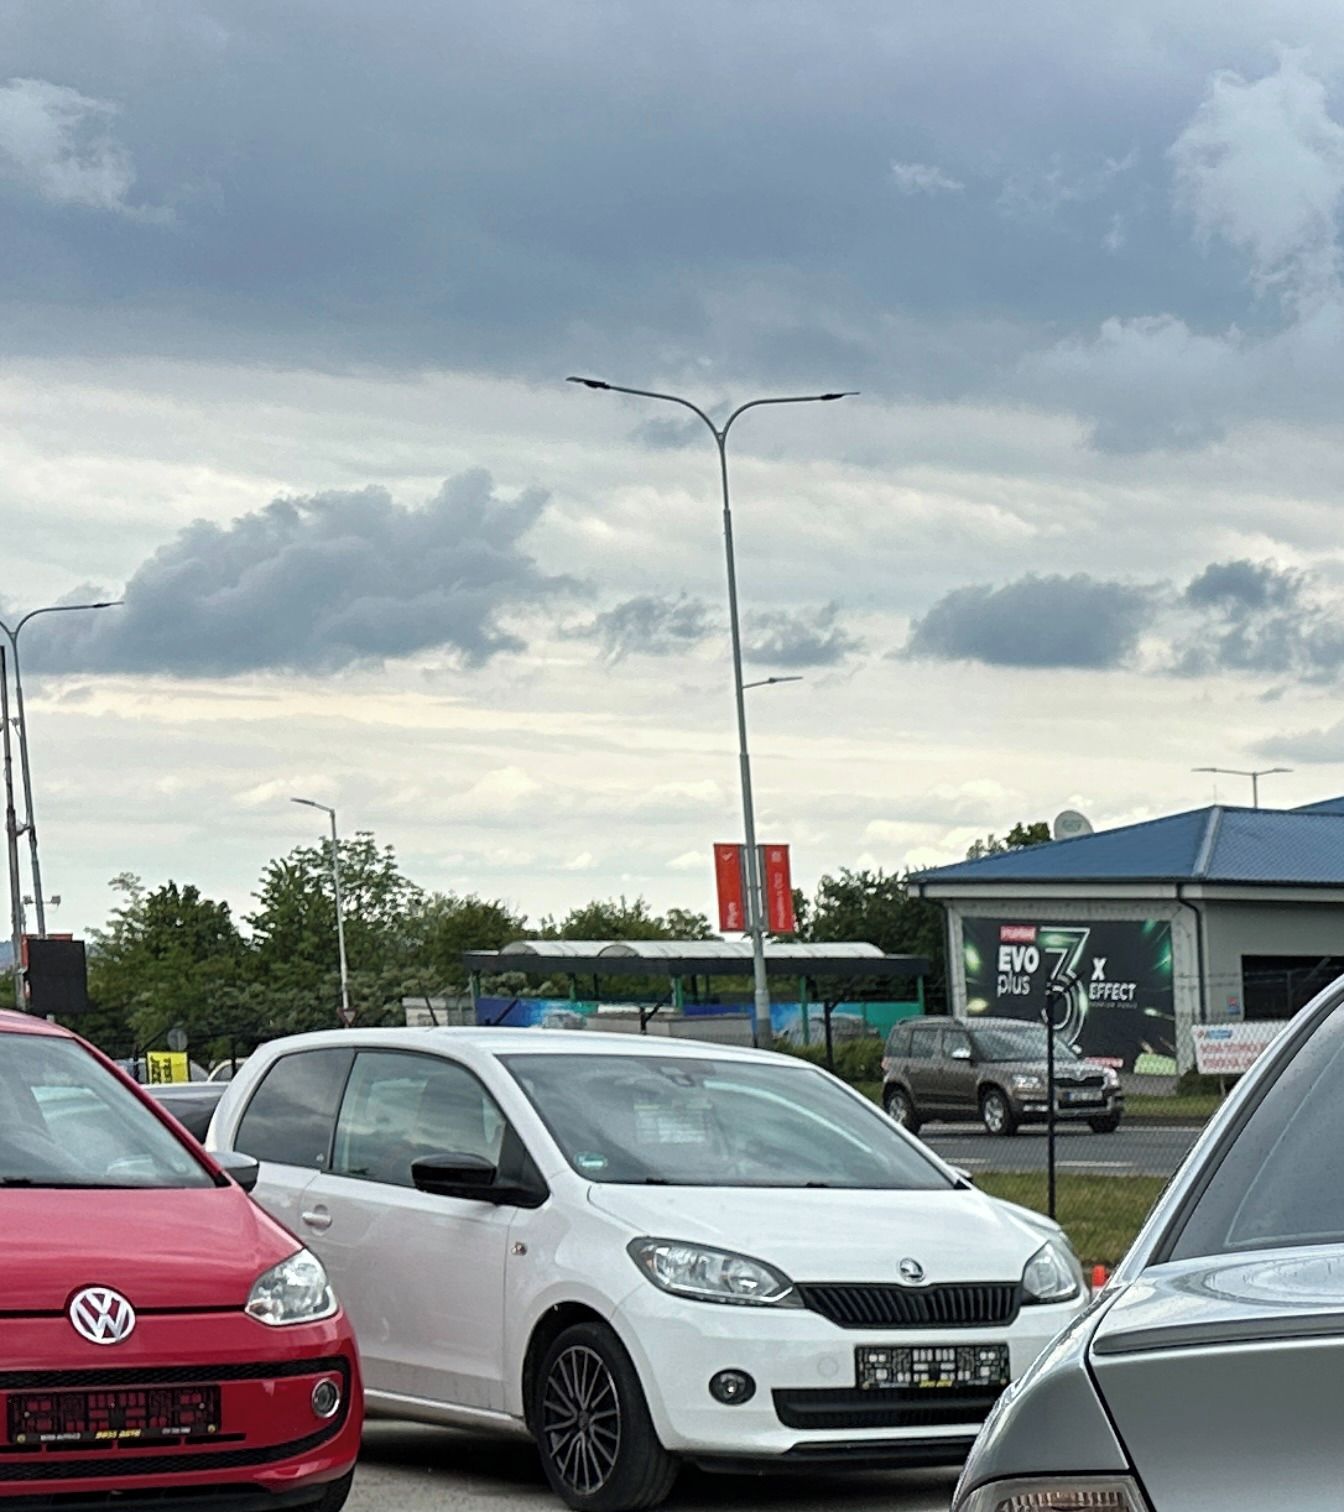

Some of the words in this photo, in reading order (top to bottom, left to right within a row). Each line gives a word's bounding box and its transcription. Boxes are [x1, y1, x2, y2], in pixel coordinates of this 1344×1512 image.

[997, 945, 1040, 974] EVO
[996, 971, 1031, 998] plus
[1088, 982, 1137, 1001] EFFECT
